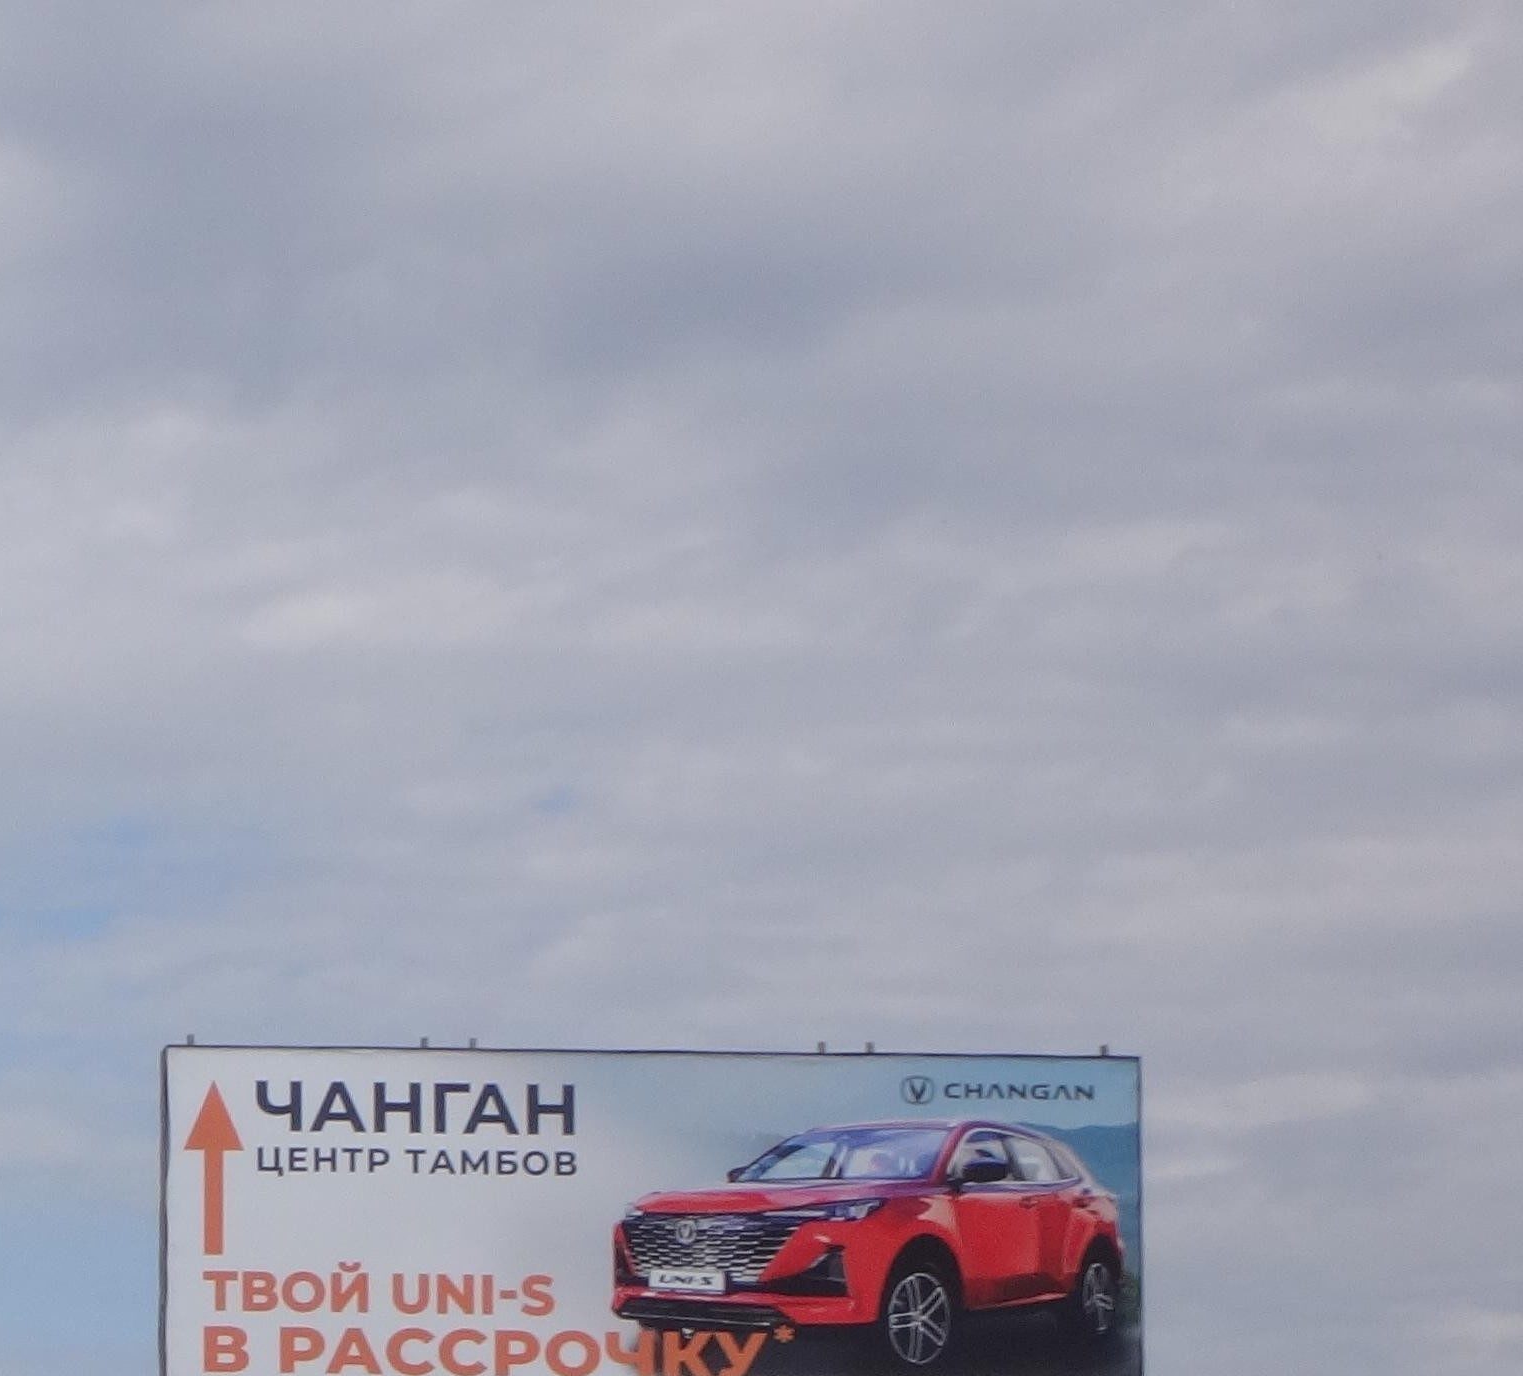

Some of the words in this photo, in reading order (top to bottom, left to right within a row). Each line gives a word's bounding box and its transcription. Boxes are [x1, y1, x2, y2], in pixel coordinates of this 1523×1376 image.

[256, 1080, 575, 1135] ЧАНГАН
[944, 1083, 1095, 1101] CHANGAN
[257, 1147, 390, 1177] ЦЕНТР
[405, 1149, 578, 1176] ТАМБОВ
[203, 1262, 370, 1313] ТВОЙ
[393, 1274, 554, 1317] UNI-S
[203, 1326, 249, 1374] В
